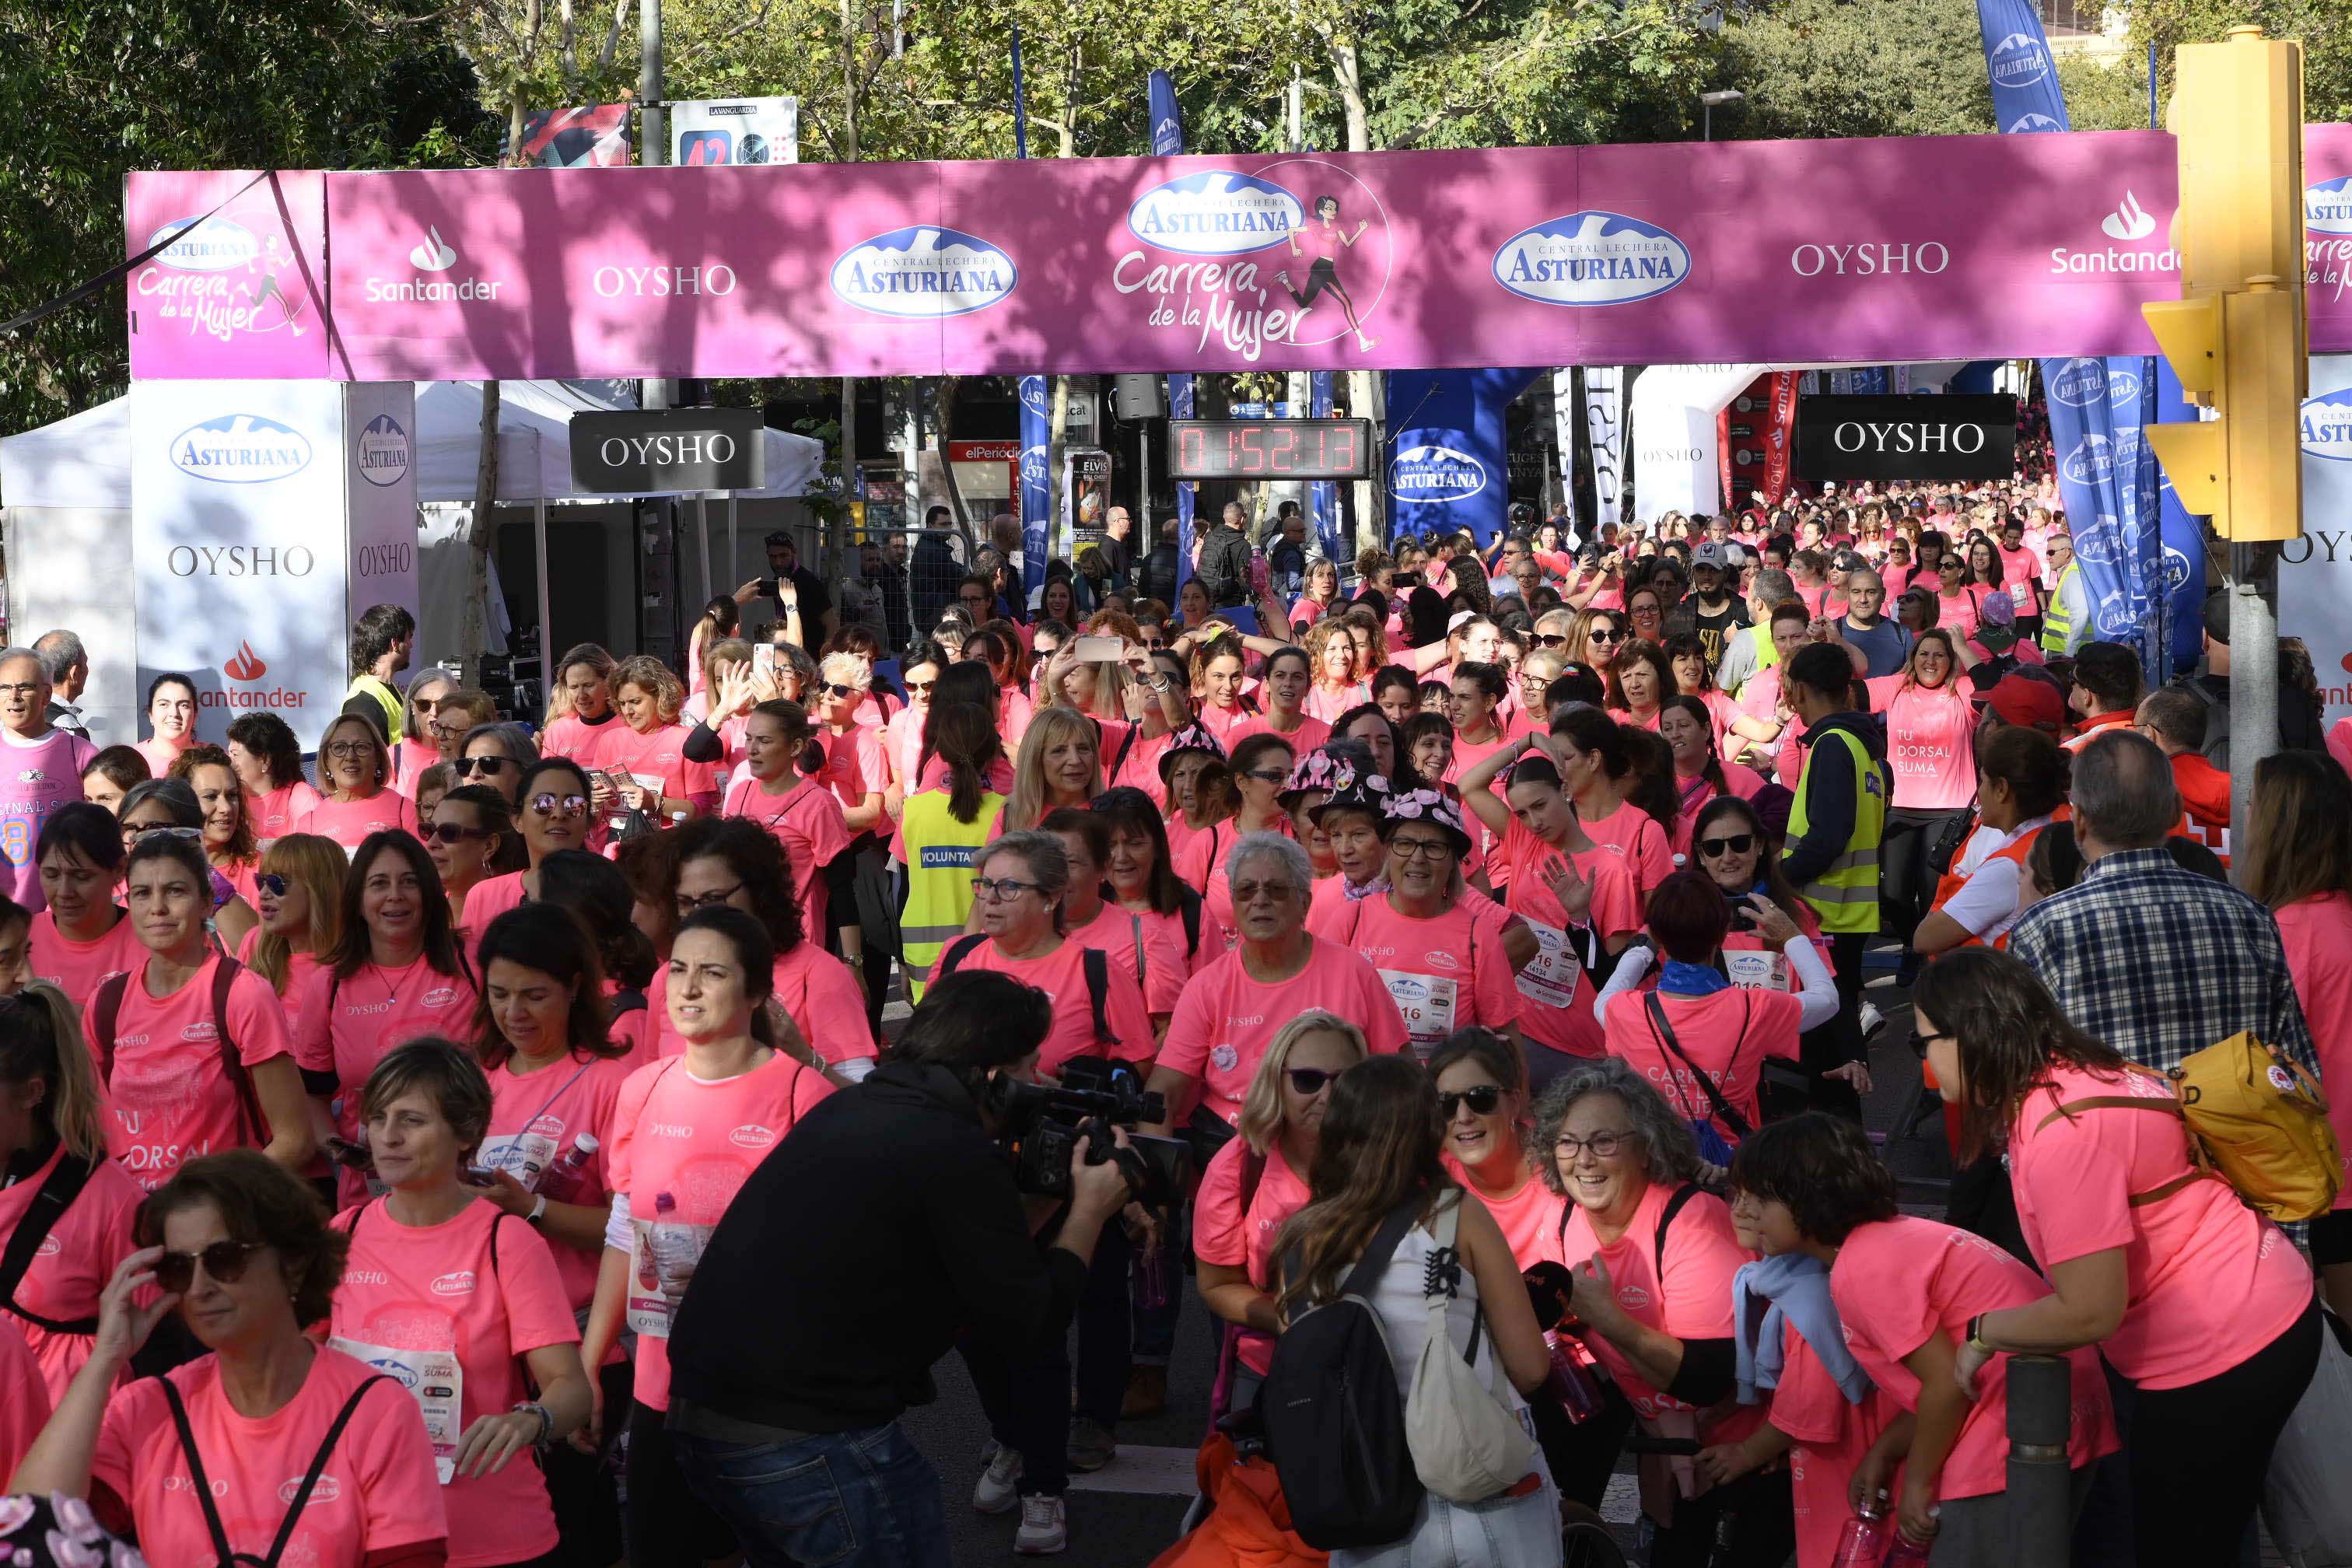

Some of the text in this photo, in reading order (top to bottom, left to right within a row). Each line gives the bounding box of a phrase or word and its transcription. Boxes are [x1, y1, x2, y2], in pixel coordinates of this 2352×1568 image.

[1230, 198, 1286, 208] LECHERA
[1142, 202, 1291, 234] ASTURIANA
[1538, 243, 1668, 254] CENTRAL LECHERA
[1791, 242, 1949, 276] OYSHO
[873, 257, 996, 266] CENTRAL LECHERA
[1113, 250, 1258, 294] Carrera
[1507, 247, 1675, 282] ASTURIANA
[137, 268, 229, 296] Carrera
[593, 265, 737, 296] OYSHO
[846, 261, 1004, 293] ASTURIANA
[2323, 262, 2337, 284] la
[366, 277, 502, 301] Santander
[160, 296, 264, 341] de la Mujer
[1149, 288, 1312, 361] de la Mujer
[1834, 422, 1984, 453] OYSHO
[180, 439, 301, 467] ASTURIANA
[361, 439, 408, 470] ASTURIANA
[601, 434, 736, 467] OYSHO
[1181, 428, 1355, 471] 01:52:13
[1643, 447, 1703, 463] OYSHO
[1083, 462, 1108, 471] ELVIS
[1391, 471, 1479, 489] ASTURIANA
[168, 545, 314, 577] OYSHO
[359, 542, 411, 577] OYSHO
[199, 687, 307, 709] antander
[1898, 730, 1913, 741] TU
[1898, 746, 1951, 758] DORSAL
[1898, 761, 1937, 773] SUMA
[1428, 955, 1456, 967] ASTURIANA
[1529, 964, 1547, 977] 14134
[1732, 963, 1768, 972] ASTURIANA
[1391, 985, 1425, 996] ASTURIANA
[346, 1003, 389, 1016] OYSHO
[1664, 1083, 1711, 1099] DE L
[1671, 1101, 1713, 1115] UJE
[733, 1132, 772, 1143] ASTURIANA
[164, 1477, 228, 1497] OYO
